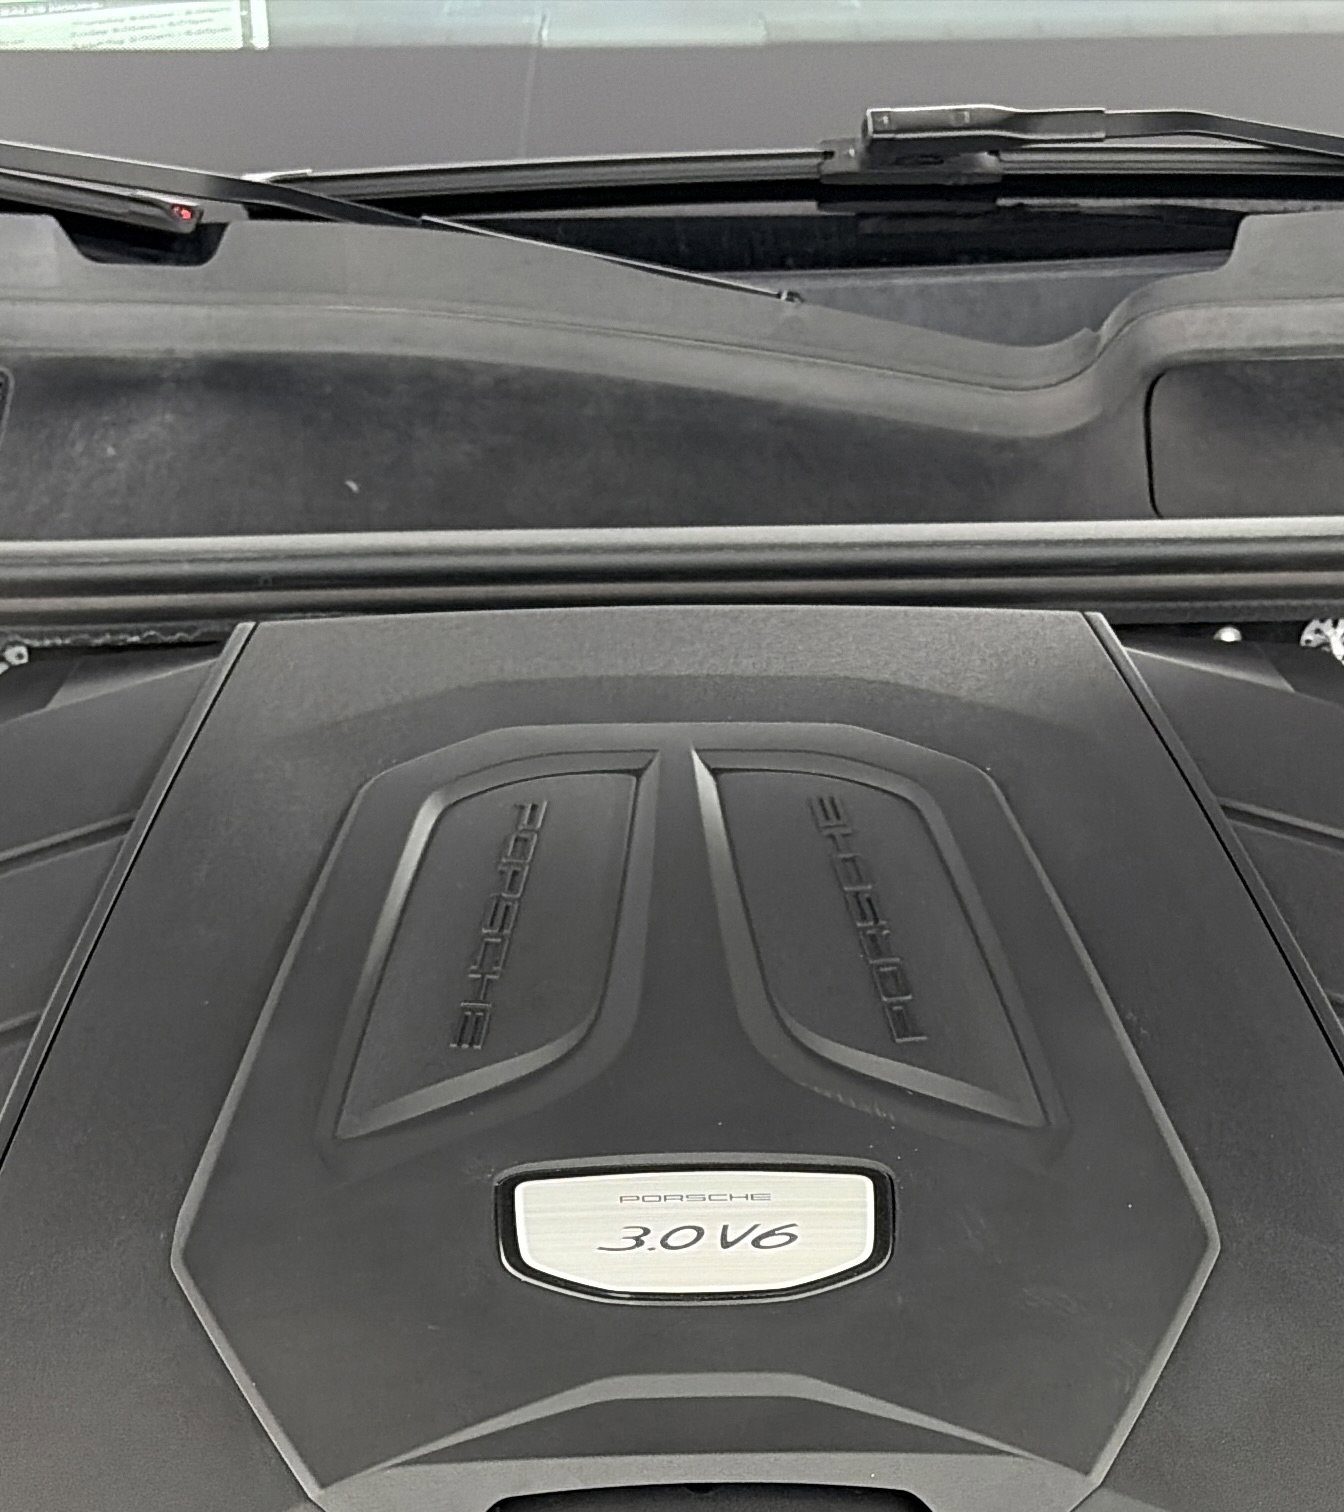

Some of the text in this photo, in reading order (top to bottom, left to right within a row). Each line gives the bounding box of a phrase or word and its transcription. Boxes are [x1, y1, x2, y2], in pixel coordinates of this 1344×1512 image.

[619, 1193, 772, 1203] PORSCHE
[597, 1223, 799, 1251] 3.0 V6
